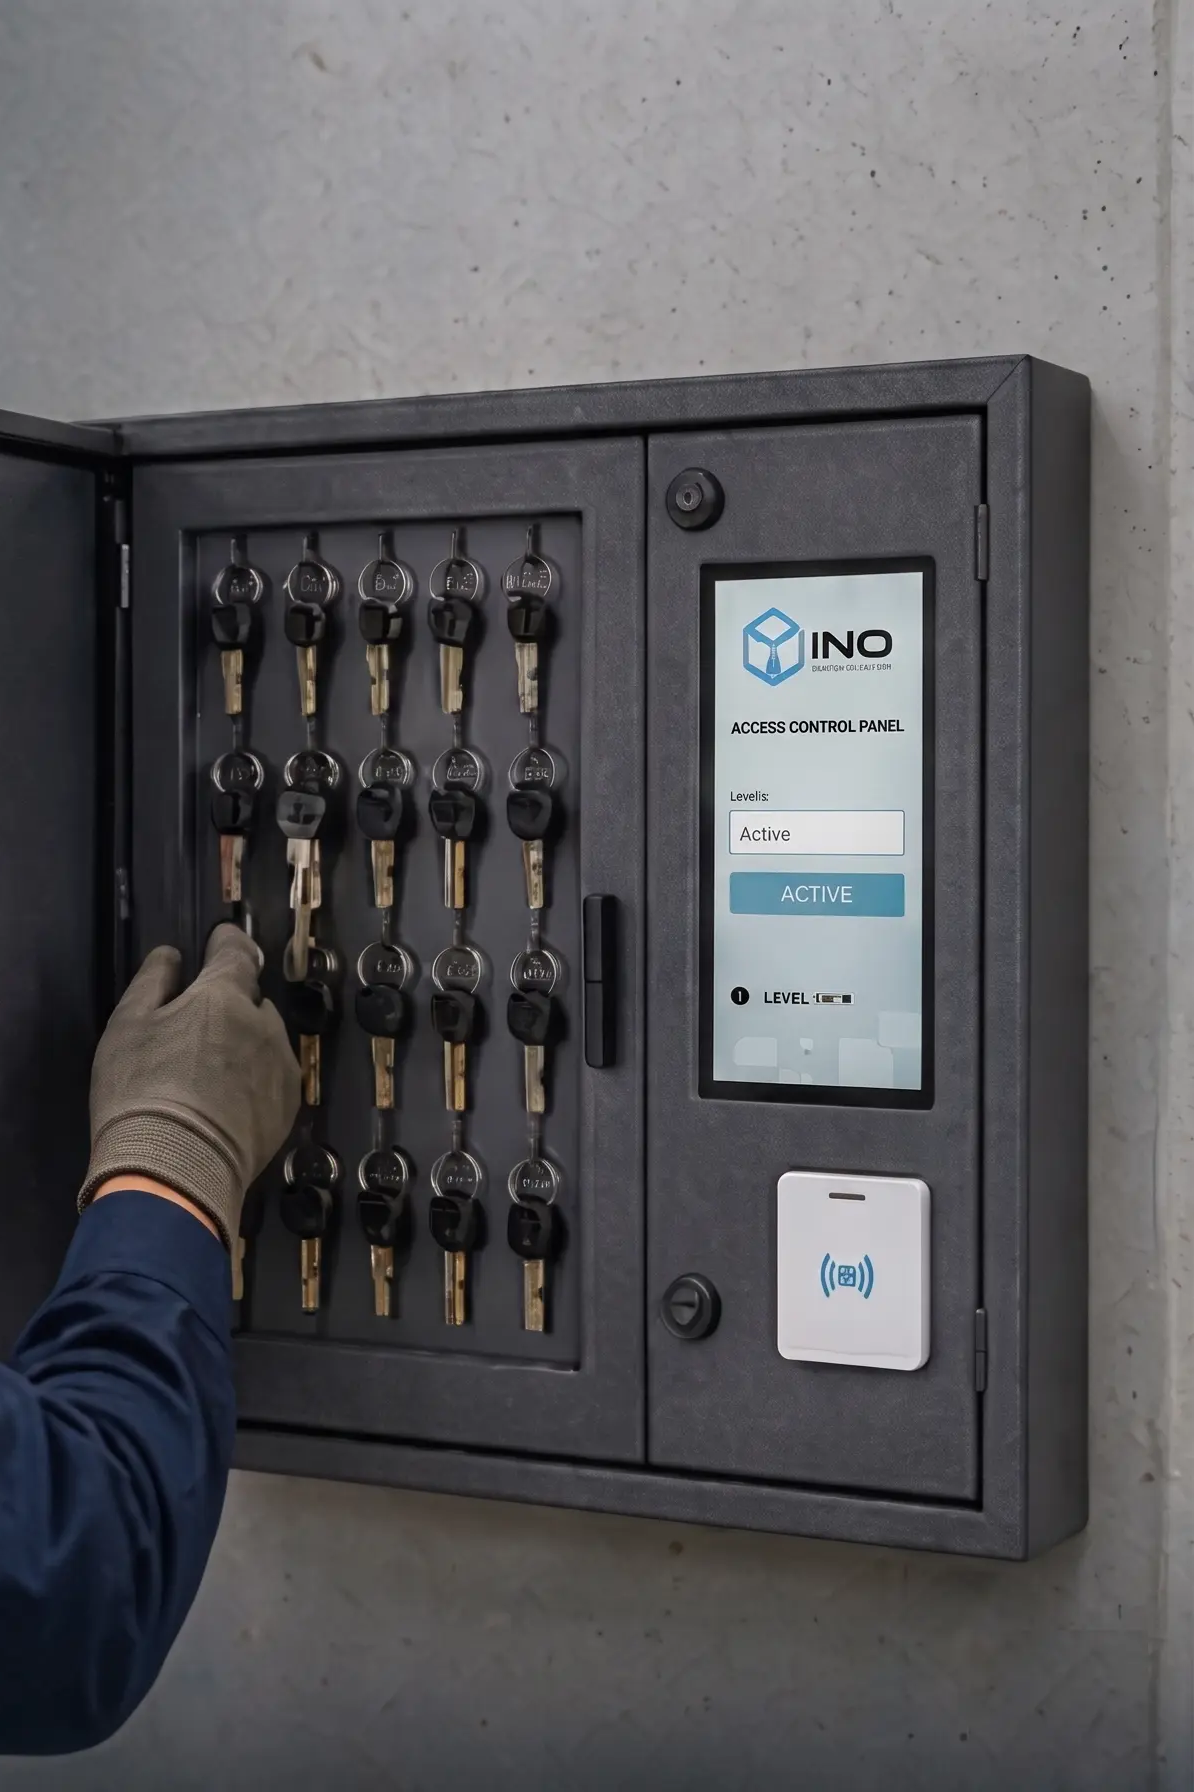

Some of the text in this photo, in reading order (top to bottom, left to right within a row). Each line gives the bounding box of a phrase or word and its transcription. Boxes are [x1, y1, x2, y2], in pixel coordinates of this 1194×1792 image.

[812, 629, 892, 659] INO
[731, 719, 904, 735] ACCESS CONTROL PANEL
[740, 826, 791, 842] Active
[781, 885, 853, 904] ACTIVE
[764, 991, 810, 1005] LEVEL
